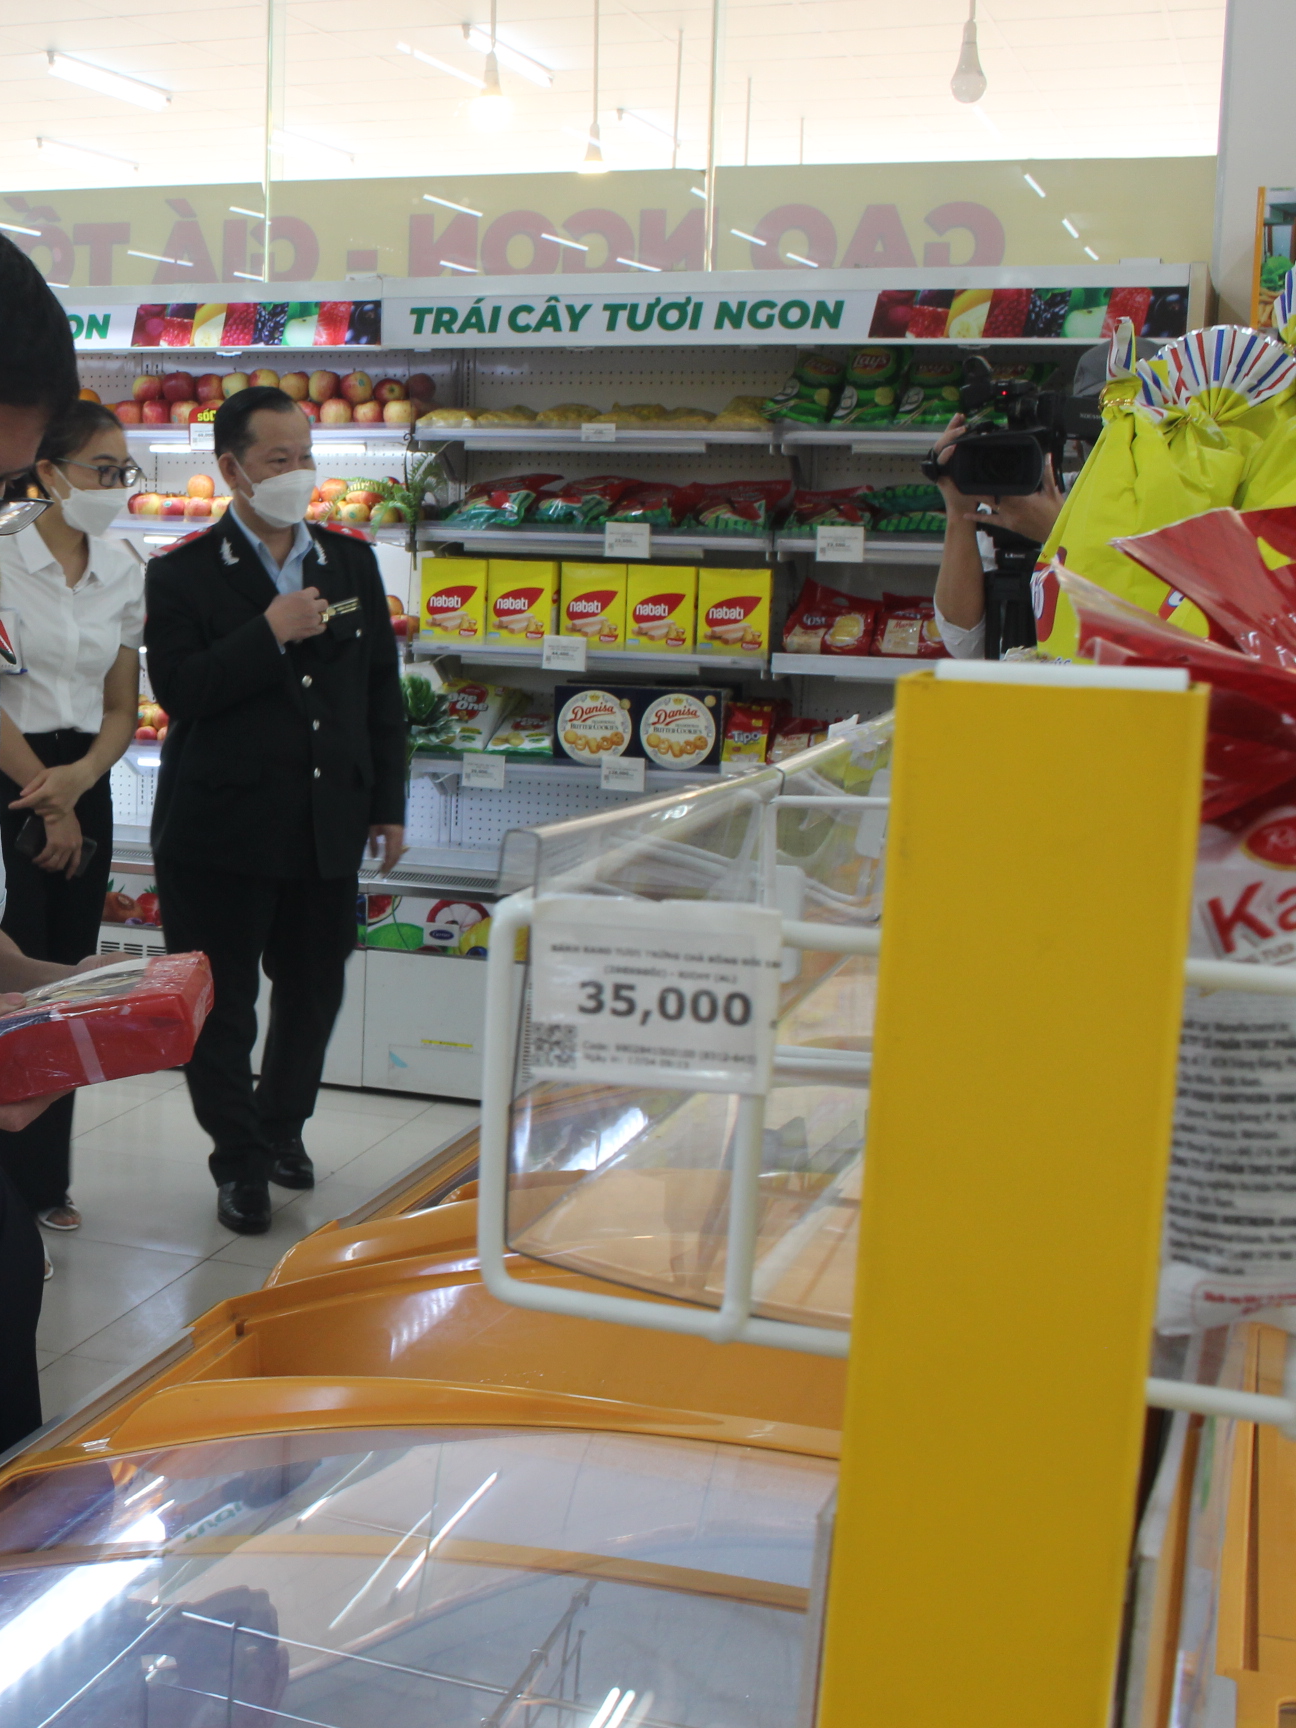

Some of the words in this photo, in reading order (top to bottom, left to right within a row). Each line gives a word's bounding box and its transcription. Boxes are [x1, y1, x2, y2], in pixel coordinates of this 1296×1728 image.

[409, 299, 501, 335] TRÁI
[507, 296, 593, 333] CÂY
[602, 295, 704, 332] TƯƠI
[713, 299, 845, 331] NGON
[65, 313, 112, 340] ON
[429, 594, 461, 608] nabati
[496, 596, 528, 610] nabati
[569, 600, 601, 614] nabati
[635, 603, 669, 617] nabati
[709, 606, 744, 620] nabati
[568, 702, 616, 723] Danisa
[651, 705, 700, 727] Danisa
[577, 980, 753, 1026] 35,000
